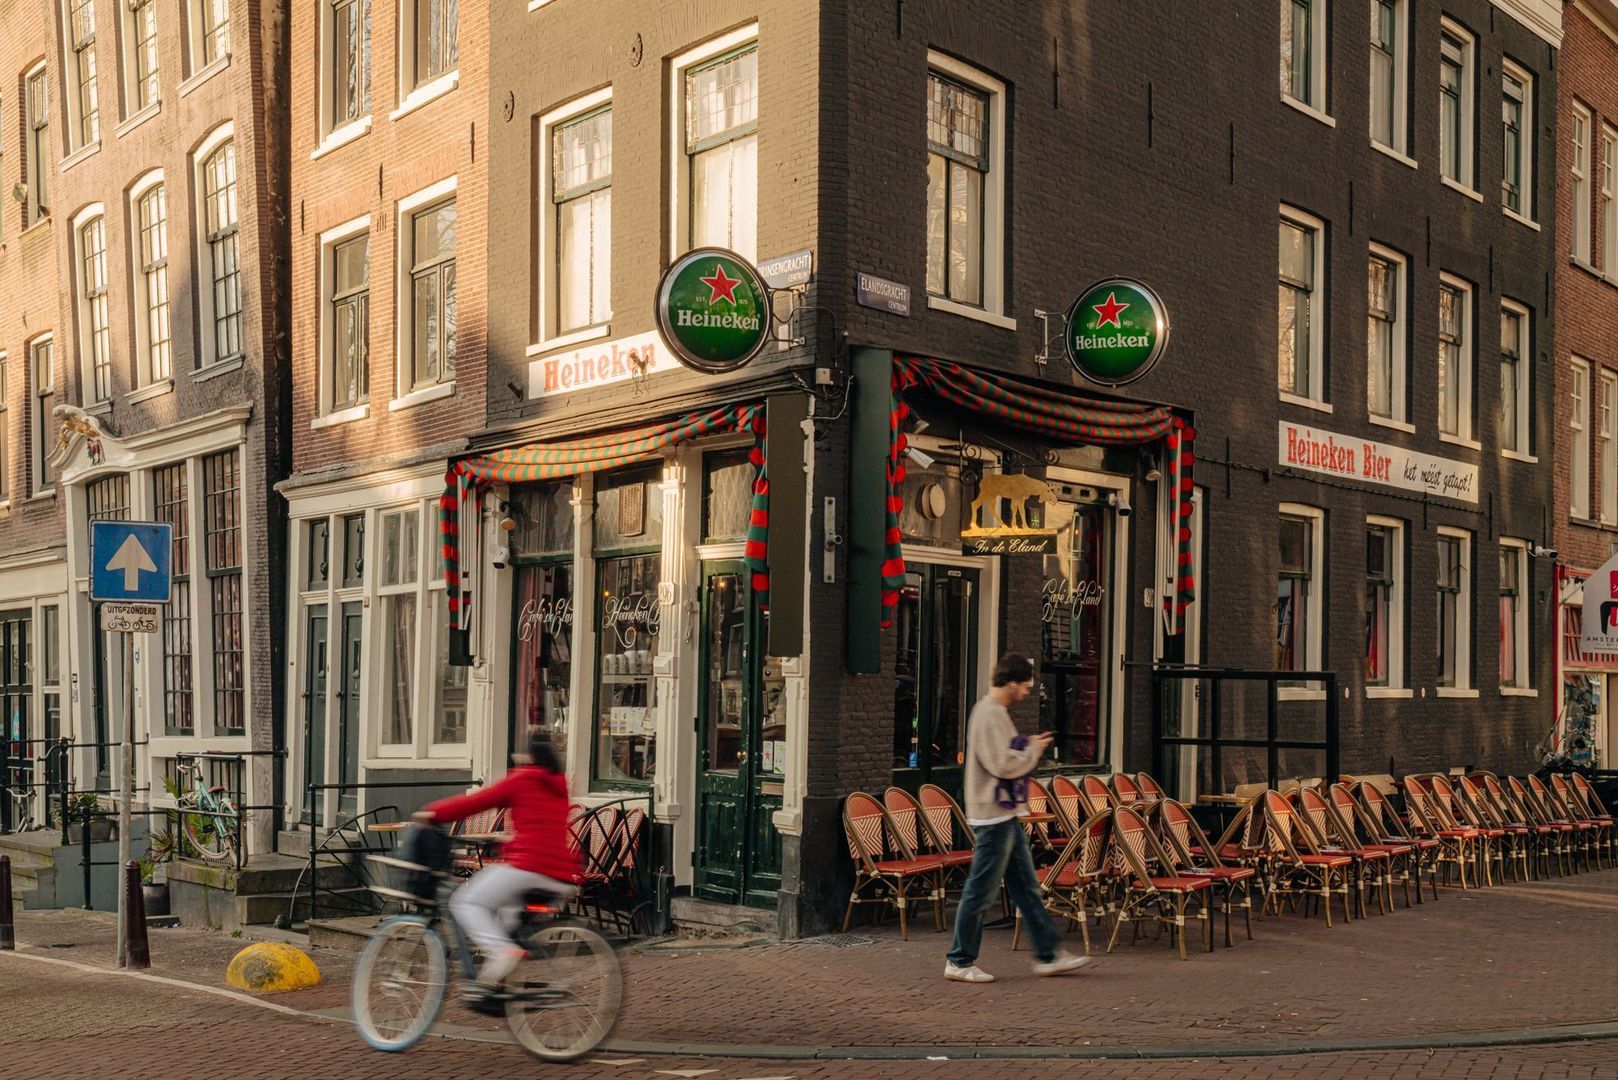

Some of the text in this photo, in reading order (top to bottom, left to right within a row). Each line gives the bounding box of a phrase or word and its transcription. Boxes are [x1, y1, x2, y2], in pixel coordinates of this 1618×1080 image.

[861, 276, 907, 301] ELANDSGRACHT
[887, 301, 907, 313] CENTRUM
[677, 309, 759, 331] Heineken
[1075, 333, 1149, 350] Heineken
[1287, 427, 1355, 475] Heineken
[1362, 442, 1393, 483] Bier
[1403, 457, 1418, 481] het
[1442, 472, 1473, 497] getapt!
[972, 538, 1048, 554] In de Eland
[107, 605, 157, 616] UITGEZONDERD
